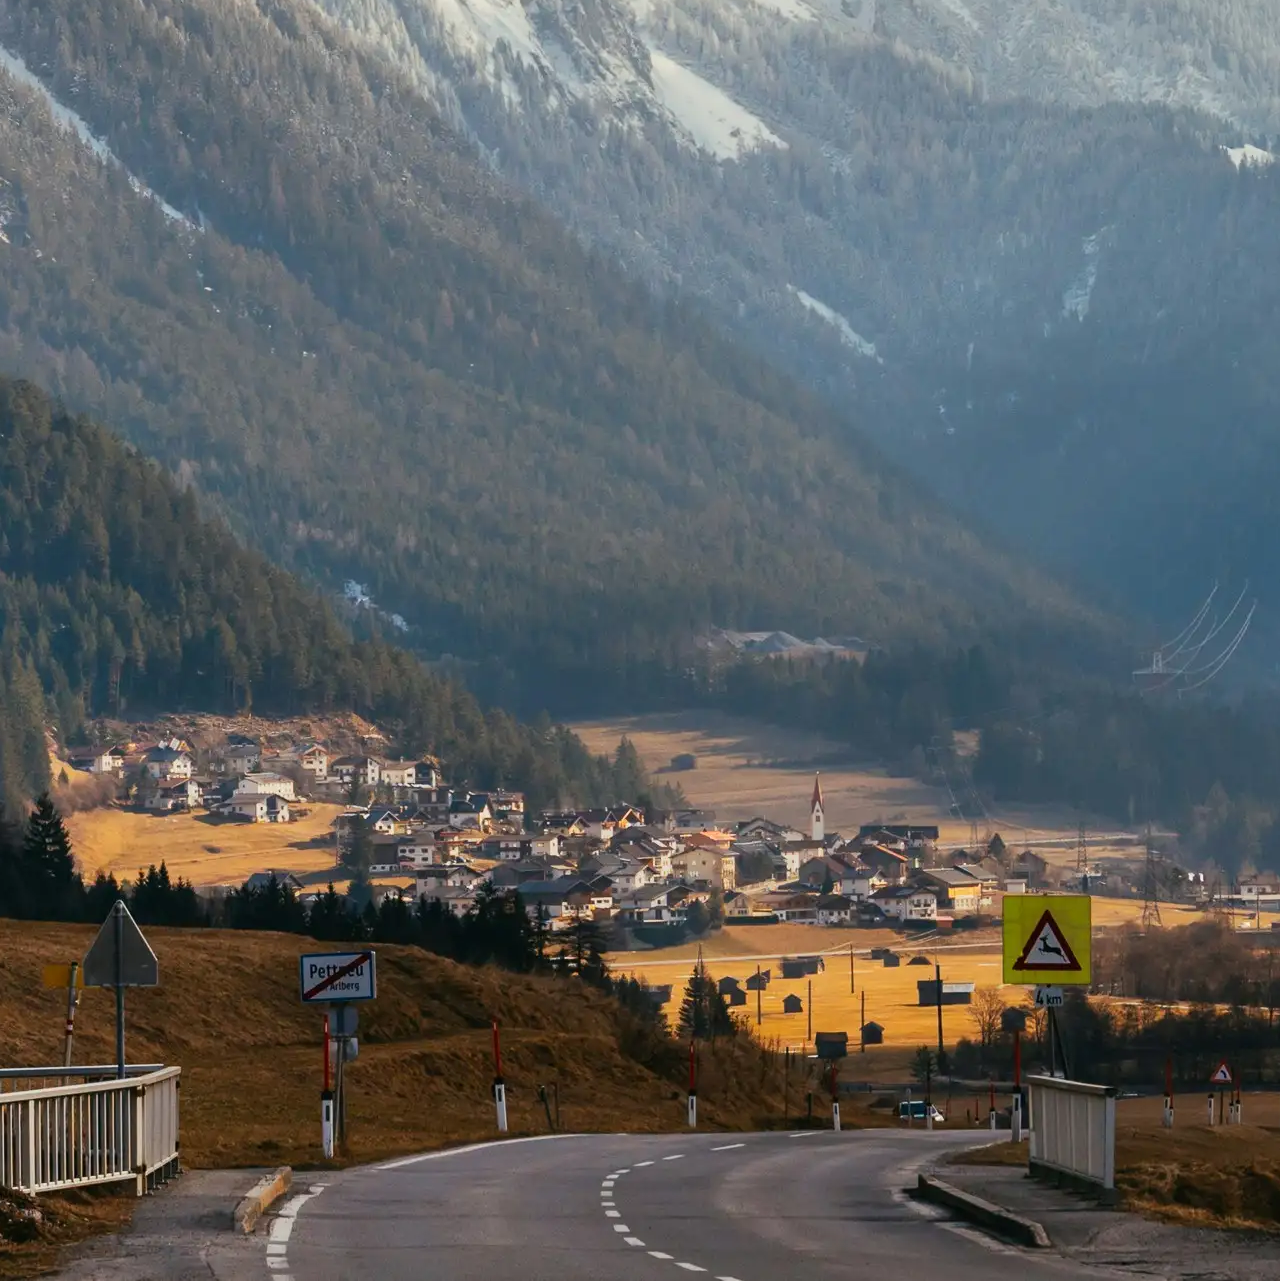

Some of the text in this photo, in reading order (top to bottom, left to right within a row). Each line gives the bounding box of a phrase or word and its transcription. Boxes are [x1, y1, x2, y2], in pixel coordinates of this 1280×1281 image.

[309, 963, 364, 979] Petteu
[329, 981, 360, 992] Arlberg
[1036, 990, 1062, 1005] 4 km
